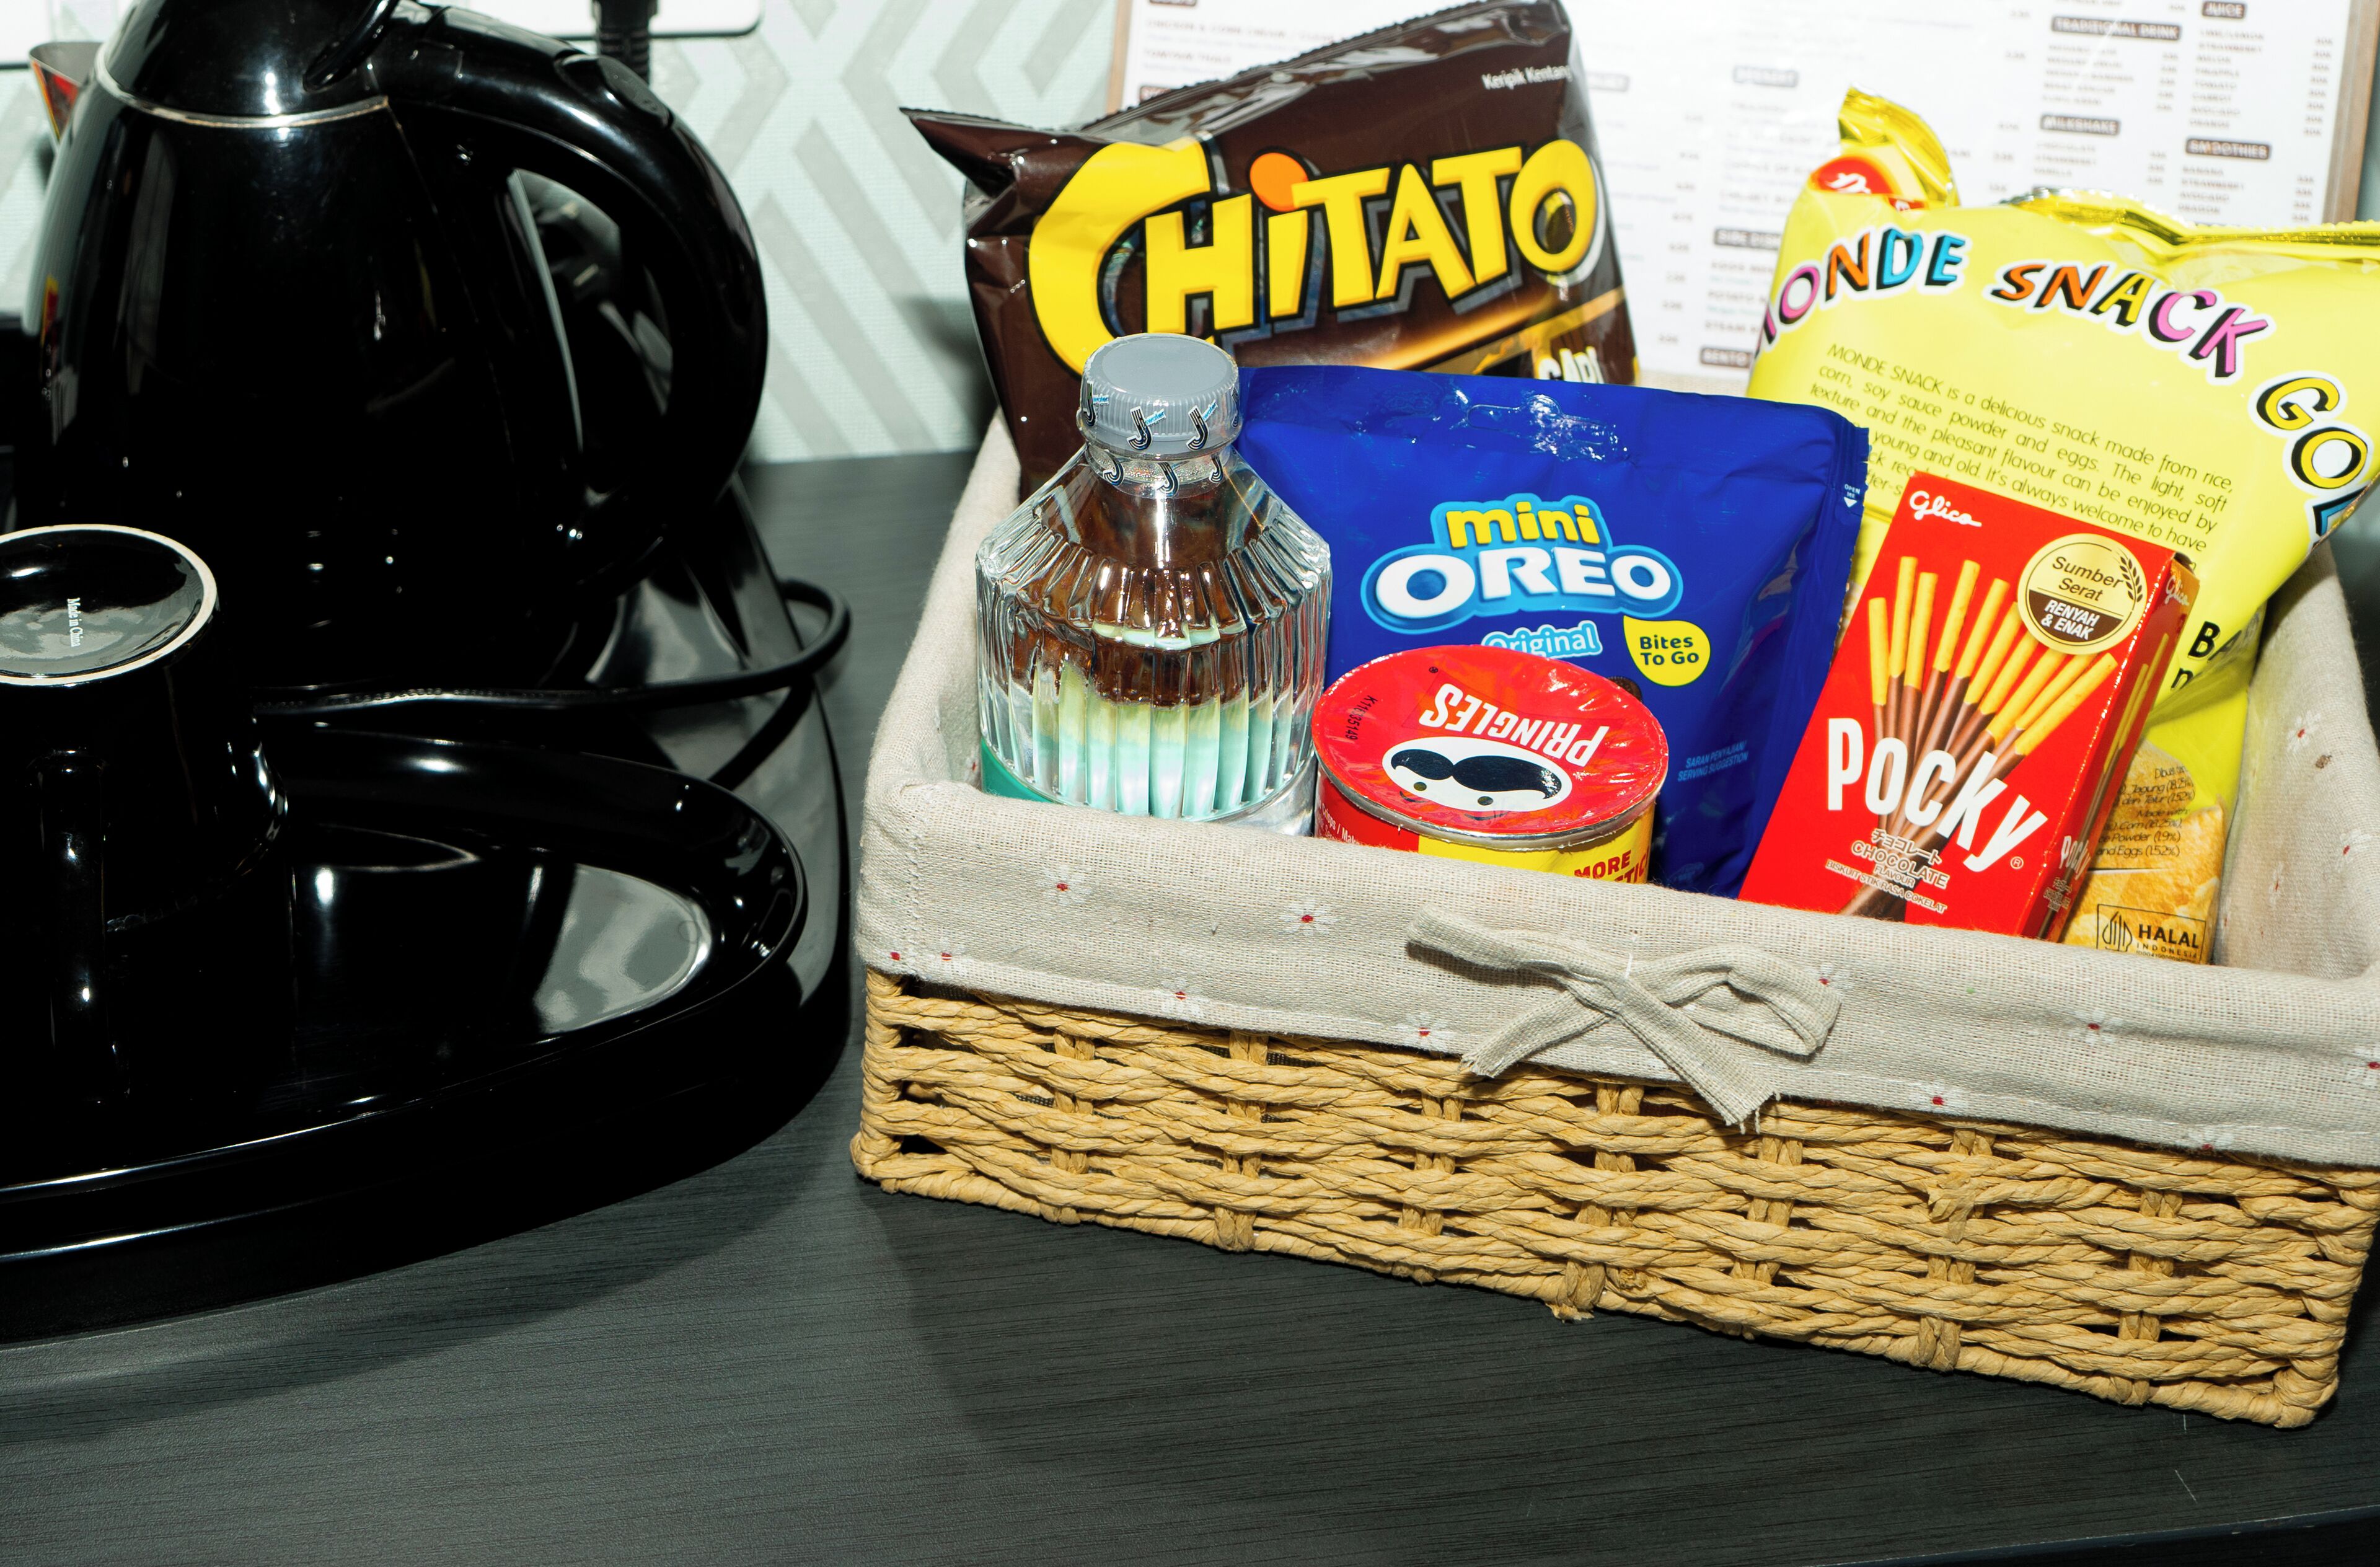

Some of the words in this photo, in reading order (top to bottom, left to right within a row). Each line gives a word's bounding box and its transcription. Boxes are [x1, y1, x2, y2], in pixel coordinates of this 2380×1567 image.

[2205, 1, 2243, 17] JUICE
[2056, 17, 2136, 36] TRADITIONAL
[2141, 24, 2177, 38] DRINK
[1481, 68, 1527, 90] Keripik
[1525, 64, 1574, 82] Kentang
[2043, 115, 2117, 135] MILKSHAKE
[2190, 139, 2268, 159] SMOOTHIES
[1991, 264, 2269, 377] SNACK
[1827, 343, 1888, 376] MONDE
[1890, 366, 1944, 395] SNACK
[1947, 386, 1959, 400] is
[1964, 392, 1975, 405] a
[1981, 395, 2046, 430] delicious
[2052, 422, 2100, 448] snack
[2105, 439, 2154, 465] made
[2159, 454, 2198, 480] from
[2203, 472, 2233, 493] rice,
[1818, 365, 1853, 389] corn,
[1863, 381, 1890, 400] soy
[1898, 393, 1942, 417] sauce
[1949, 410, 2008, 439] powder
[2016, 432, 2049, 453] and
[2057, 447, 2100, 472] eggs.
[2112, 462, 2141, 485] The
[2151, 475, 2185, 501] light,
[2195, 492, 2228, 514] soft
[1809, 382, 1860, 410] texture
[1866, 405, 1898, 425] and
[1902, 415, 1927, 435] the
[1931, 427, 1997, 459] pleasant
[2001, 447, 2057, 480] flavour
[2062, 472, 2091, 492] can
[2098, 480, 2121, 502] be
[2127, 497, 2192, 526] enjoyed
[2196, 512, 2218, 536] by
[1844, 484, 1860, 494] OPEN
[1873, 430, 1919, 459] young
[1923, 446, 1955, 468] and
[1956, 456, 1981, 478] old.
[1986, 467, 2009, 487] It's
[2011, 476, 2069, 510] always
[2073, 500, 2144, 533] welcome
[2148, 522, 2162, 537] to
[2166, 528, 2207, 553] have
[1909, 490, 1982, 527] Glico
[1447, 501, 1600, 548] mini
[1376, 547, 1672, 619] OREO
[2052, 555, 2124, 589] Sumber
[2058, 577, 2104, 602] Serat
[2164, 575, 2190, 606] Glico
[67, 598, 81, 619] Made
[2045, 599, 2101, 627] RENYAH
[69, 619, 82, 627] in
[2040, 613, 2055, 629] &
[2053, 617, 2096, 641] ENAK
[69, 627, 83, 647] China
[1639, 635, 1693, 650] Bites
[1641, 651, 1665, 666] To
[1672, 650, 1699, 665] Go
[1419, 684, 1610, 767] PRINGLES
[1871, 828, 1942, 865] チョコレート
[2112, 832, 2151, 842] Powder
[1574, 850, 1631, 879] MORE
[1852, 841, 1950, 889] CHOCOLATE
[2117, 845, 2143, 858] Eggs
[1826, 859, 1860, 880] BISKUIT
[1860, 873, 1881, 888] STIK
[1880, 881, 1904, 899] RASA
[1905, 890, 1947, 914] COKELAT
[1874, 864, 1915, 887] FLAVOUR
[2138, 924, 2198, 949] HALAL
[2136, 942, 2197, 959] INDONESIA
